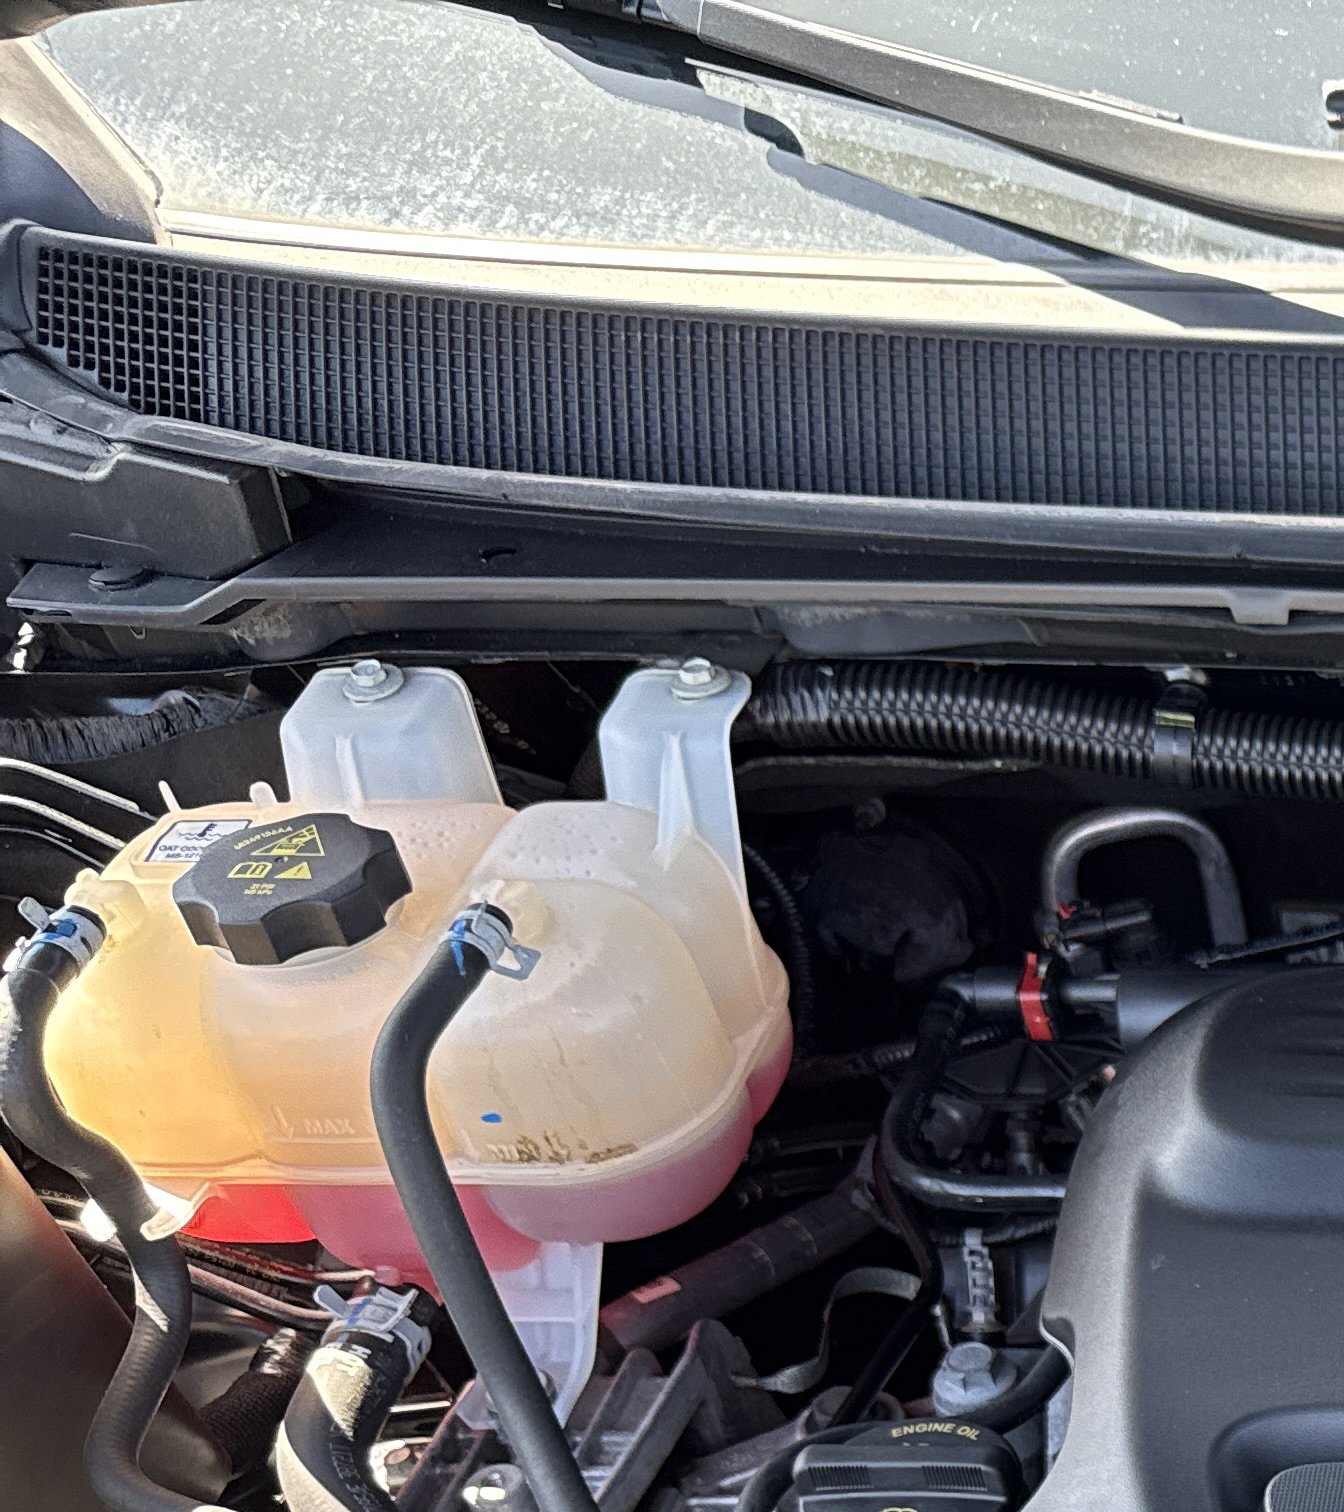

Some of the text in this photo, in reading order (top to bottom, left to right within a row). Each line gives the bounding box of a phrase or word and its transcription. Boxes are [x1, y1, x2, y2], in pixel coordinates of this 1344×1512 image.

[303, 1117, 355, 1136] MAX
[890, 1421, 983, 1441] ENGINE OIL
